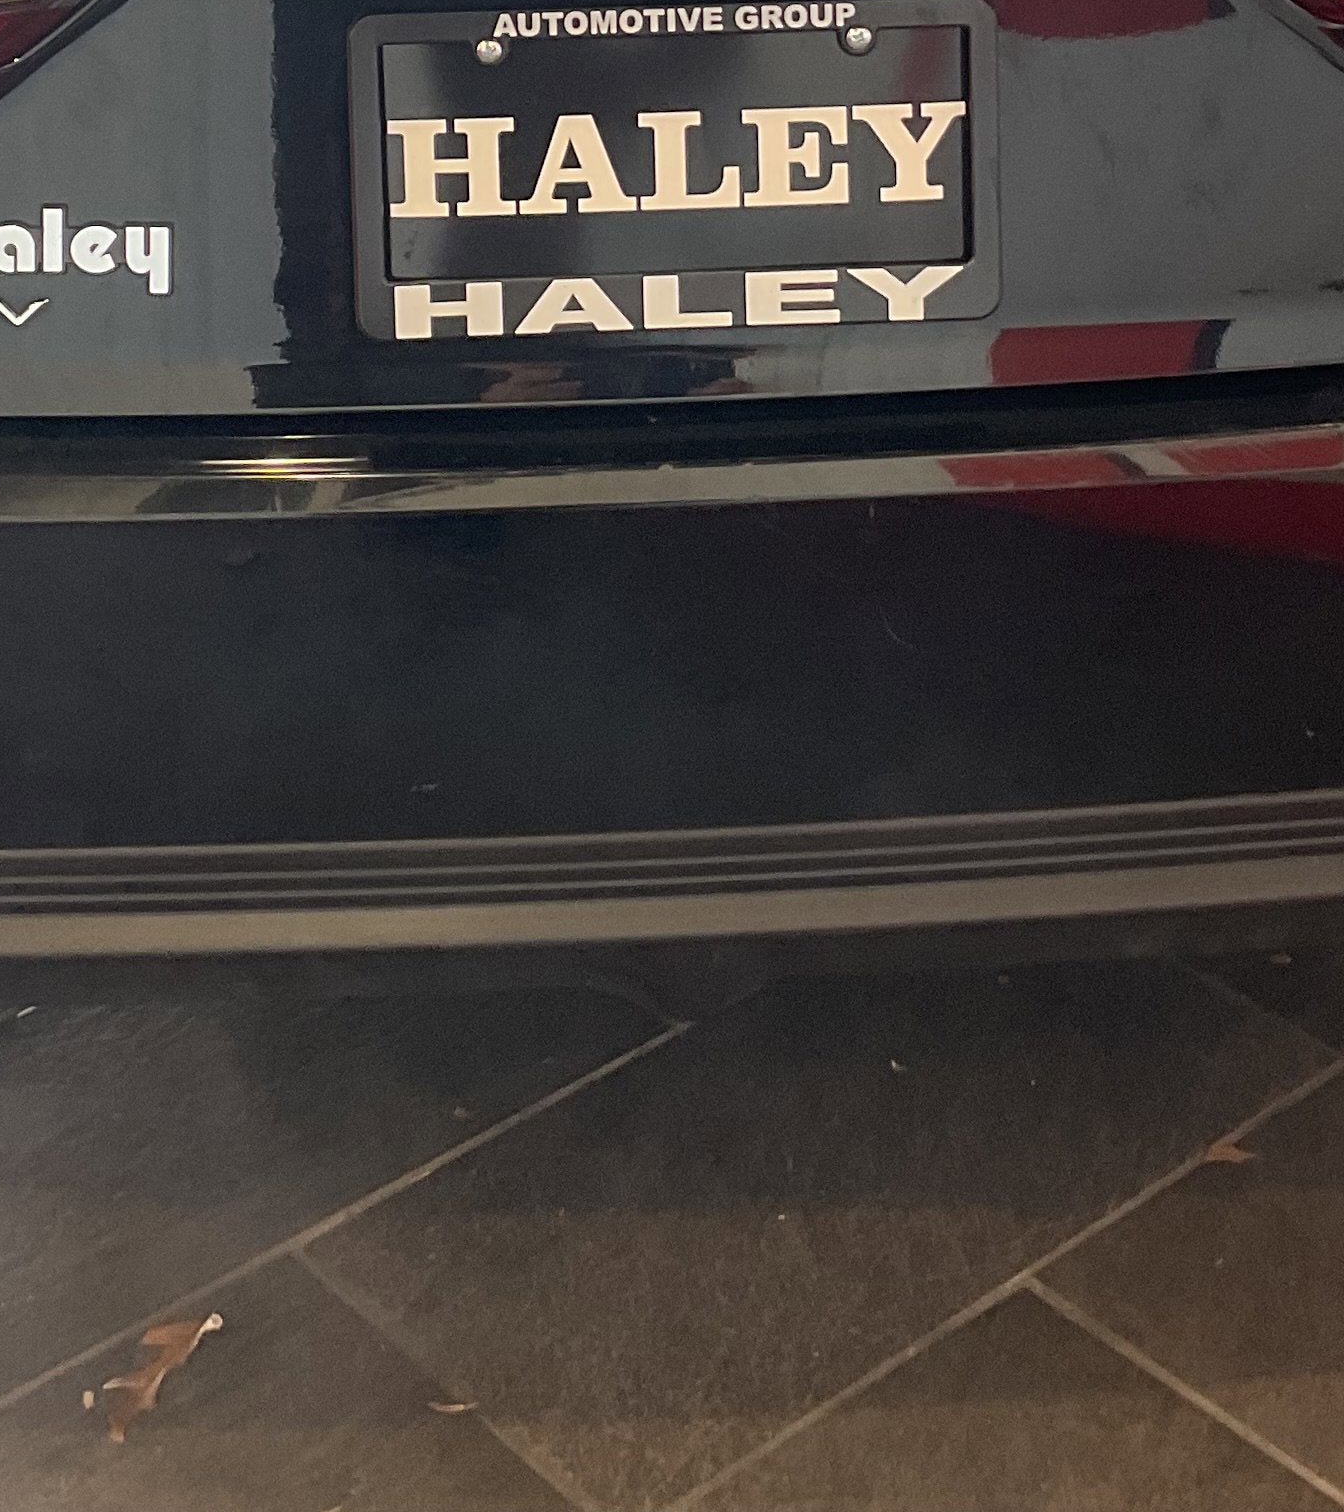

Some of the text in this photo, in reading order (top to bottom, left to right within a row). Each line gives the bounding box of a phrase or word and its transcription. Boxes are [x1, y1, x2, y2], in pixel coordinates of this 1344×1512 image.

[493, 1, 857, 39] AUTOMOTIVE GROUP
[386, 101, 967, 219] HALEY
[393, 264, 965, 341] HALEY
